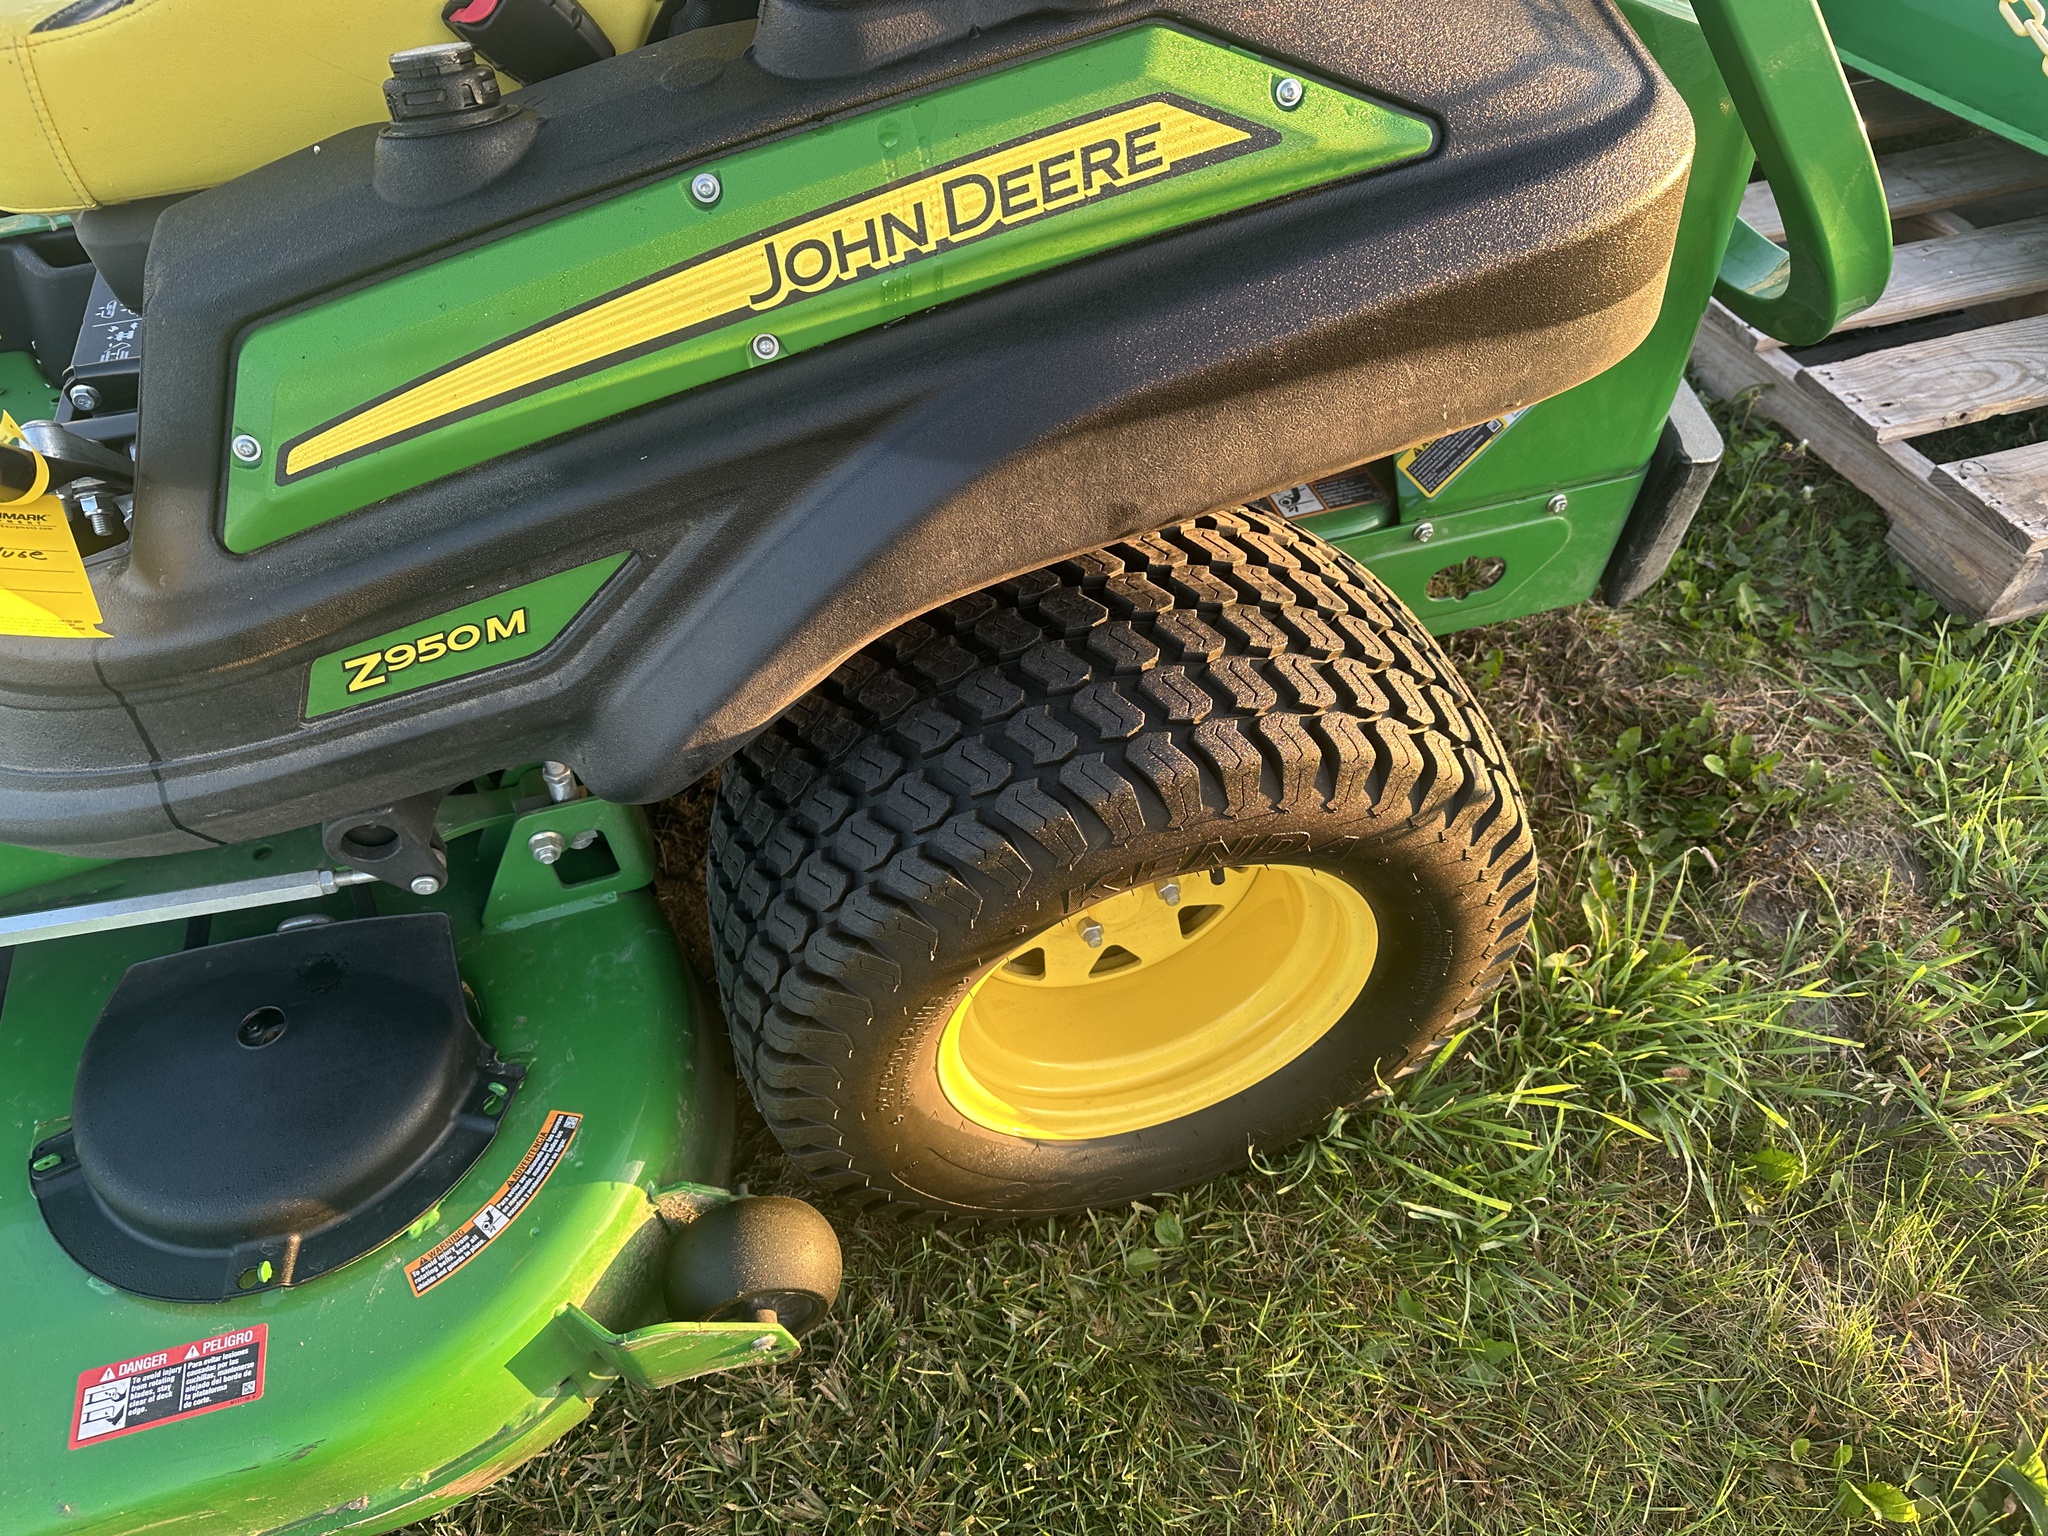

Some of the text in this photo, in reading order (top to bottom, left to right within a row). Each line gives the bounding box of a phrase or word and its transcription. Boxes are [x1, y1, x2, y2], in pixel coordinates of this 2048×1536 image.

[749, 122, 1164, 305] JOHN DEERE
[509, 1131, 547, 1179] ADVERTENCIA
[411, 1234, 469, 1277] To avoid injury from
[427, 1228, 464, 1259] WARNING
[414, 1233, 478, 1284] rotating belts, keep all
[416, 1237, 486, 1290] shields and guards in place.
[202, 1329, 252, 1353] PELIGRO
[118, 1352, 167, 1376] DANGER
[186, 1357, 238, 1377] causadas por las
[187, 1347, 248, 1369] Para evitar lesiones
[130, 1373, 175, 1392] from rotating
[131, 1364, 182, 1384] To avoid injury
[185, 1361, 254, 1386] cuchillas, mantenerse
[185, 1369, 251, 1394] alejado del borde de
[128, 1389, 172, 1408] clear of deck
[129, 1382, 171, 1401] blades, stay
[183, 1394, 212, 1408] de corte.
[184, 1392, 190, 1400] la
[191, 1382, 227, 1400] plataforma
[127, 1404, 147, 1417] edge.
